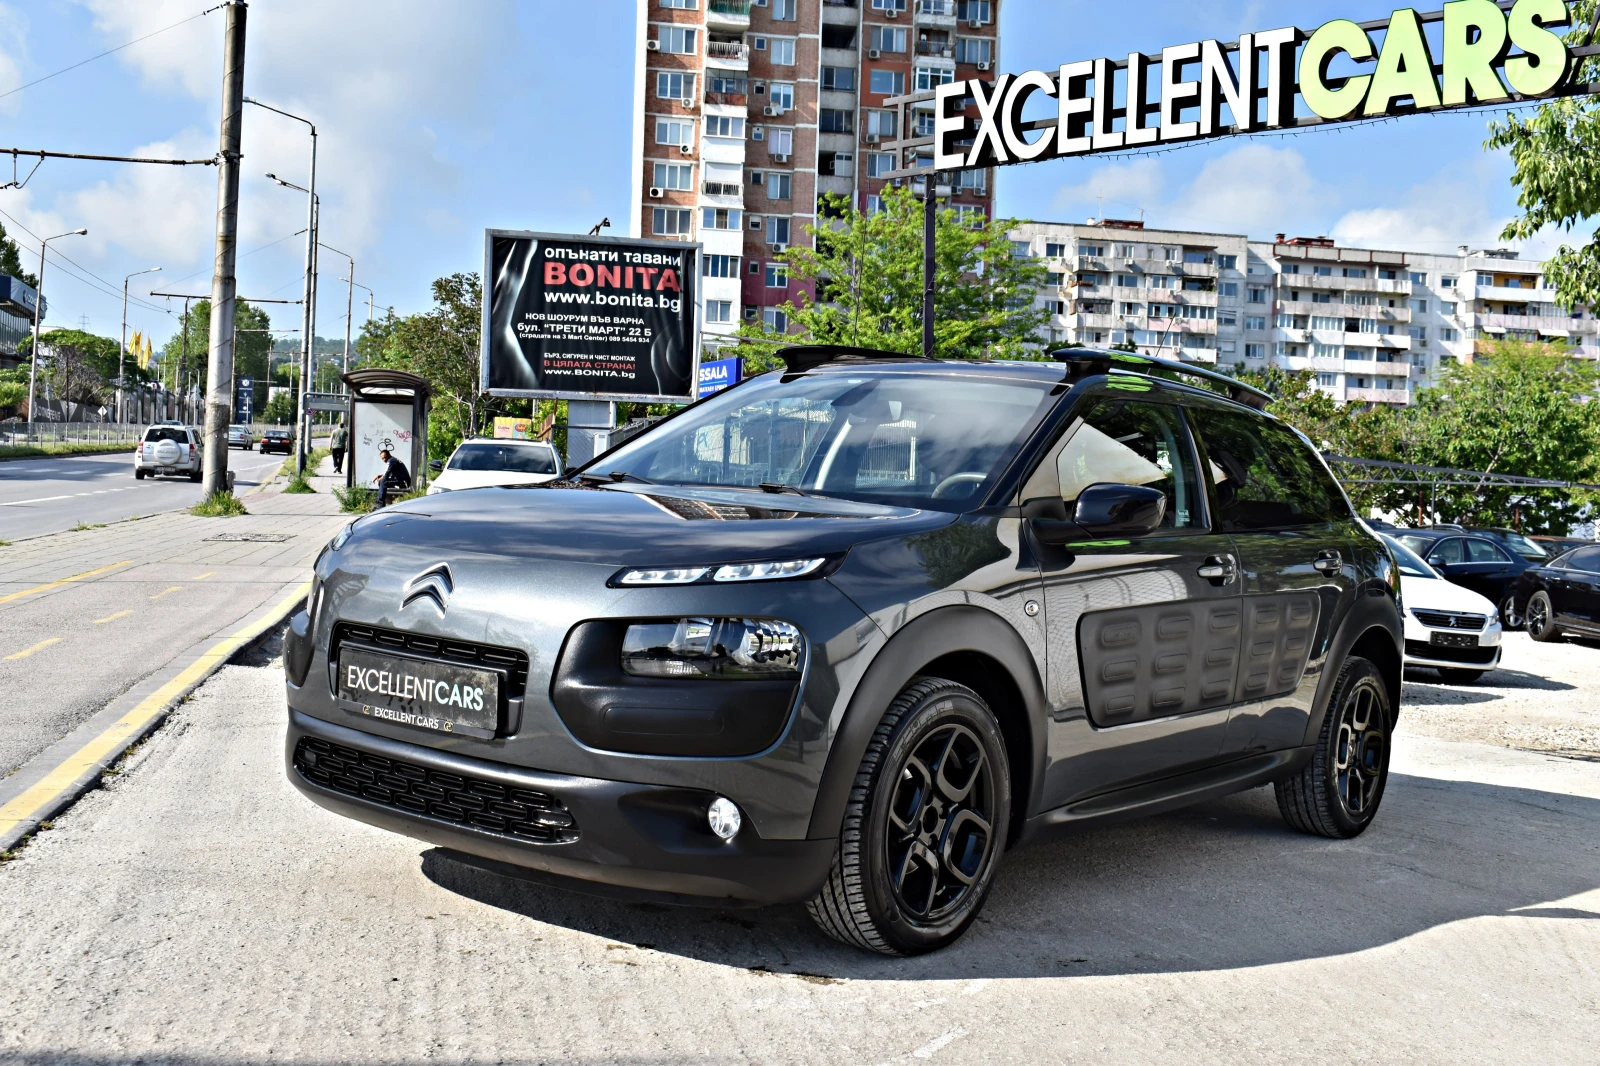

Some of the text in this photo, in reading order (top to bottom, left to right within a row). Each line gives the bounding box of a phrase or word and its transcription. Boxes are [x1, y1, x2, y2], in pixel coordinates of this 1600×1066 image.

[544, 247, 681, 267] опънати тавани
[544, 261, 681, 292] BONITA
[544, 291, 681, 312] www.bonita.bg
[547, 314, 588, 322] ШОУРУМ
[590, 315, 611, 323] ВЪВ
[613, 317, 645, 325] ВАРНА
[517, 322, 541, 333] бул.
[629, 327, 641, 336] 22
[544, 368, 636, 379] www.BONITA.bg
[553, 360, 592, 368] ЦЯЛАТА
[594, 362, 636, 370] СТРАНА!
[374, 706, 439, 730] EXCELLENT CARS
